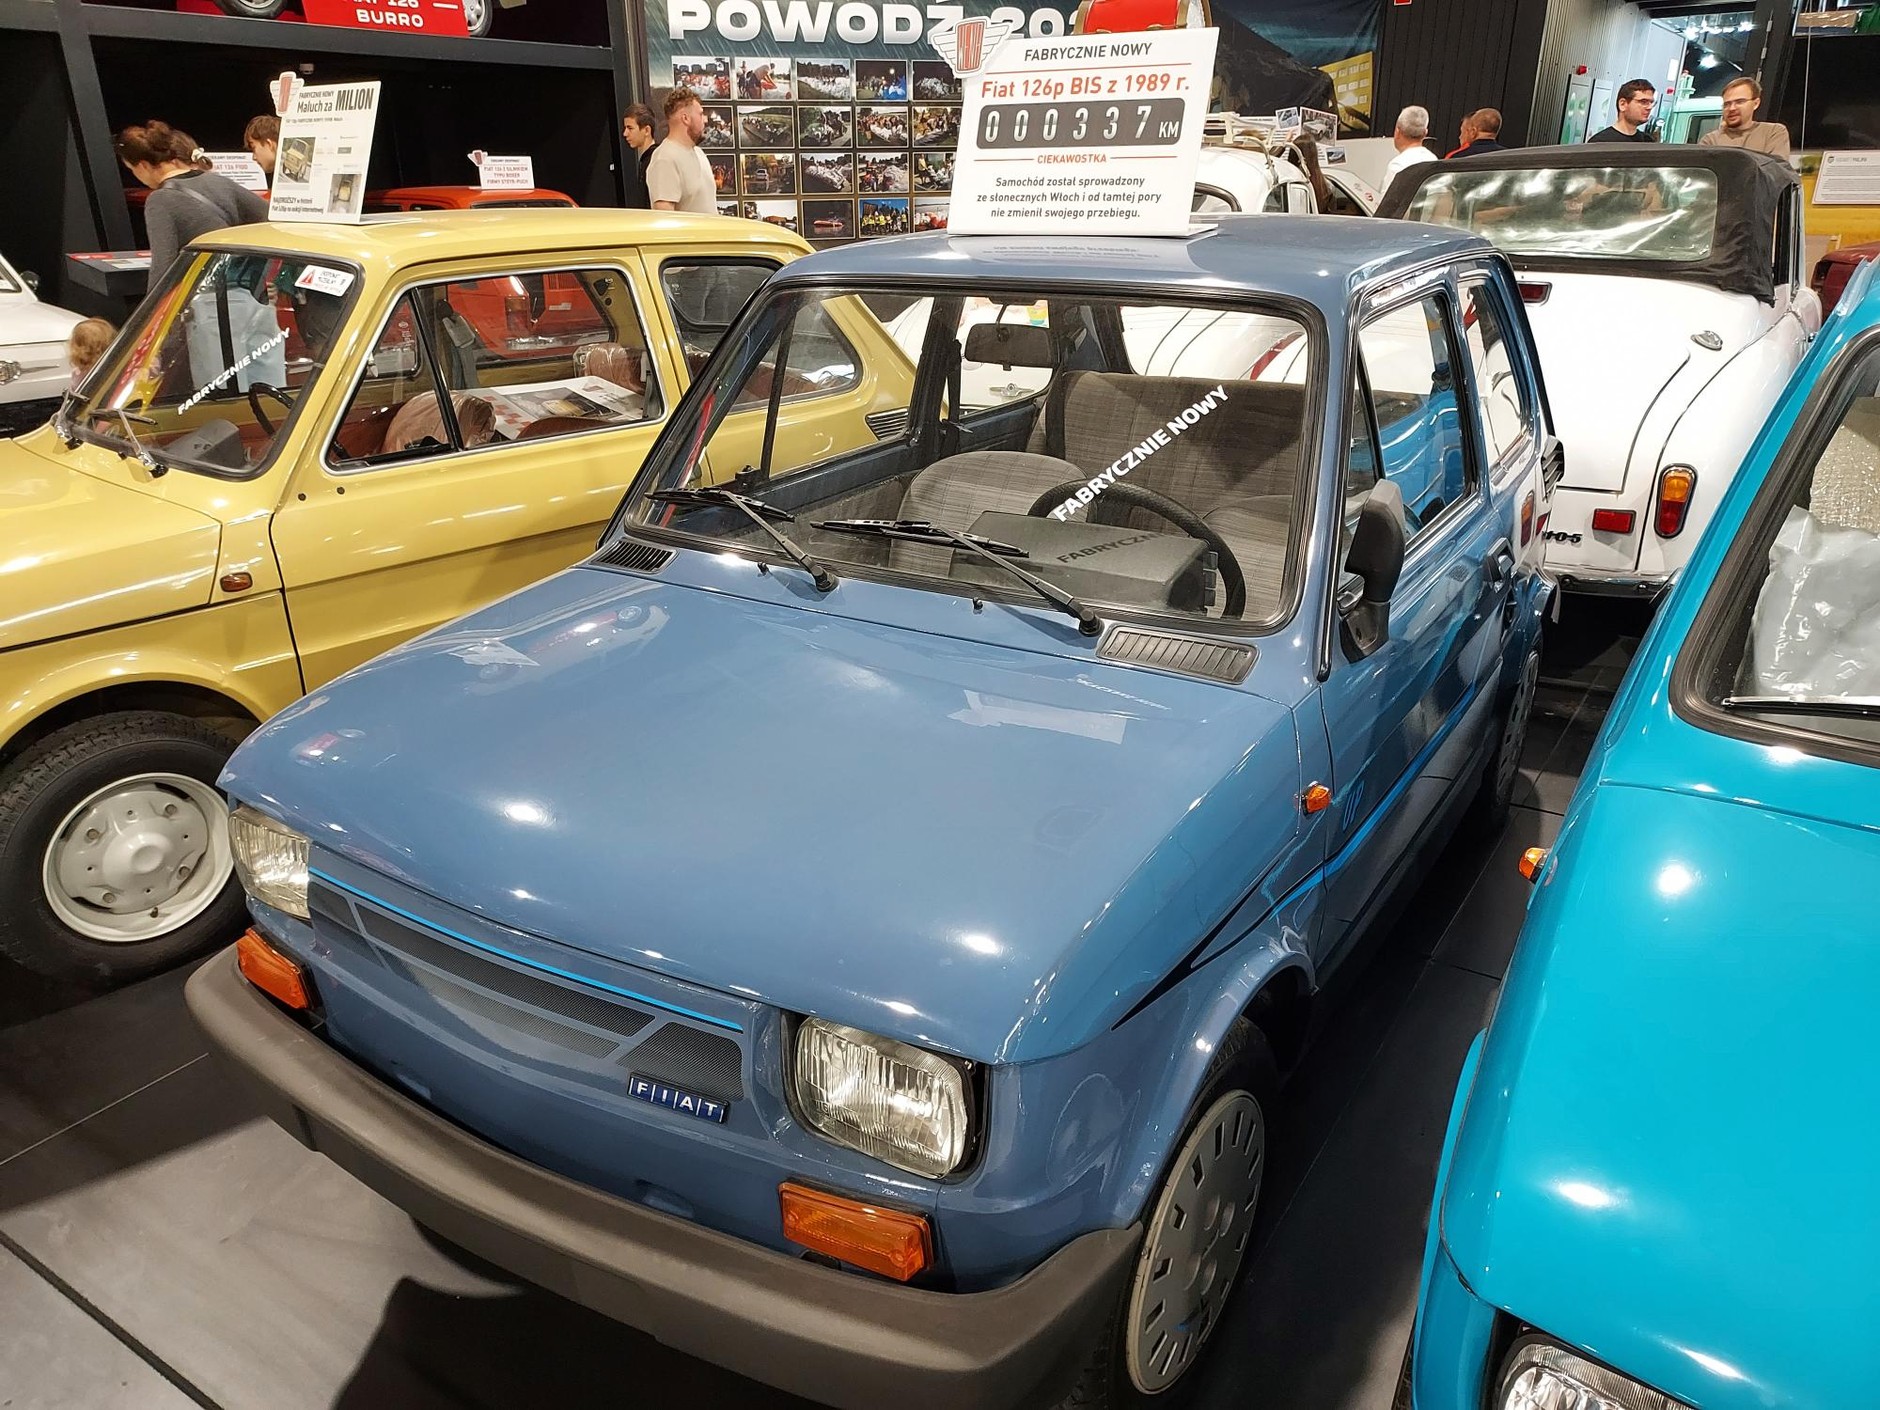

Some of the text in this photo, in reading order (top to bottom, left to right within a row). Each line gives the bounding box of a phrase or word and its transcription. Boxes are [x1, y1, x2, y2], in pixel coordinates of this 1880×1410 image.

[356, 9, 424, 28] BURRO
[1024, 42, 1153, 61] FABRYCZNIE NOWY
[981, 73, 1190, 100] Fiat 126p BIS z 1989 r.
[296, 88, 375, 114] Maluch za MILION
[1158, 120, 1180, 138] KM
[1037, 154, 1107, 164] CIEKAWOSTKA
[995, 175, 1145, 189] Samochód został sprowadzony
[977, 192, 1162, 204] ze słonecznych Włoch i od tamtej pory
[990, 208, 1141, 219] nie zmienił swojego przebiegu.
[177, 327, 290, 415] FABRYCZNIE NOWY
[1051, 384, 1229, 523] FABRYCZNIE NOWY
[635, 1080, 719, 1117] FIAT
